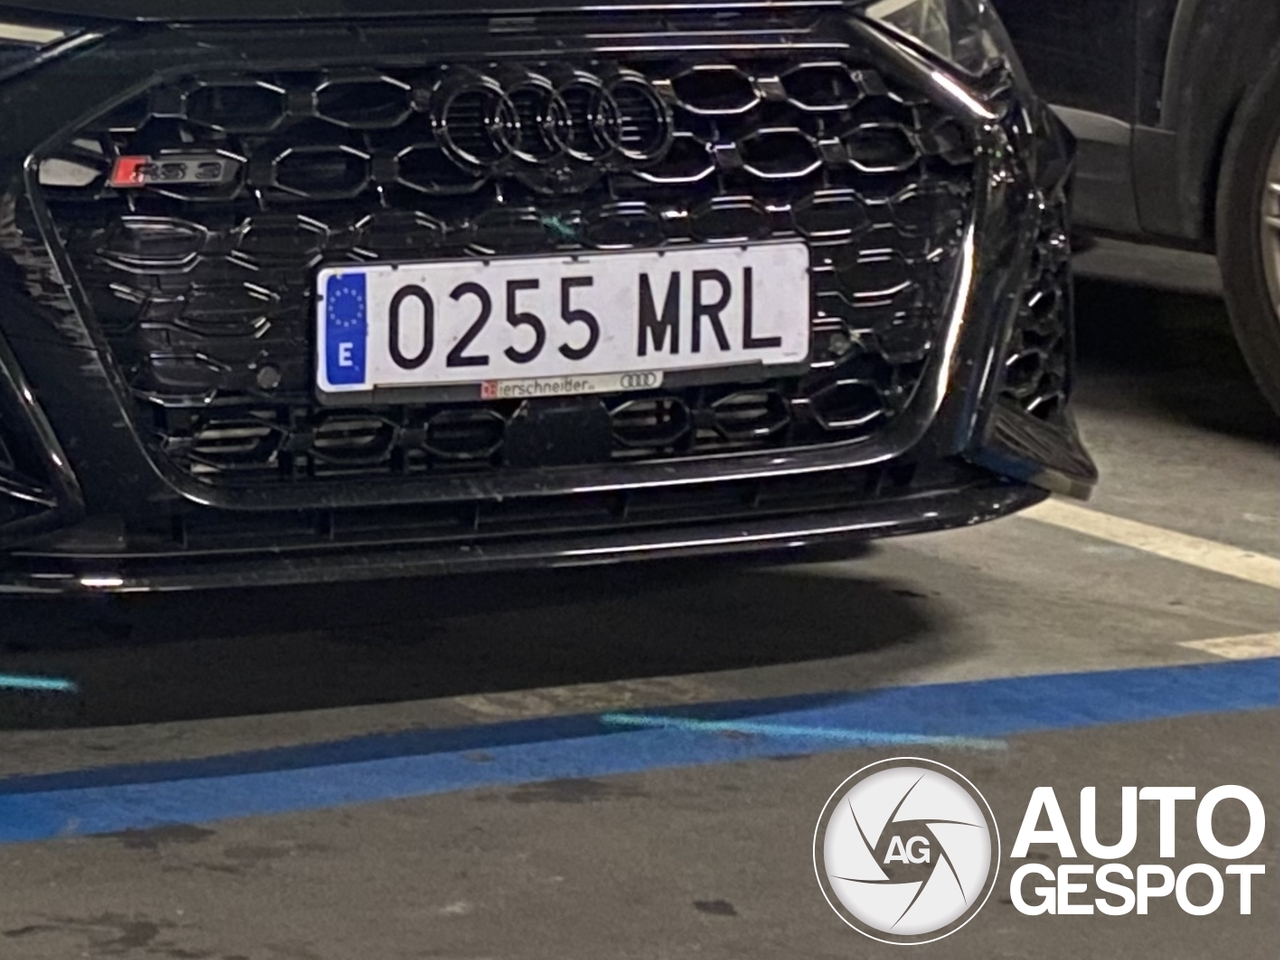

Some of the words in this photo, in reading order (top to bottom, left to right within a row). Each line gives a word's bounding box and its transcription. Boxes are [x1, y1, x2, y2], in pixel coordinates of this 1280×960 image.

[387, 275, 600, 370] 0255
[636, 266, 783, 357] MRL
[338, 341, 354, 367] E
